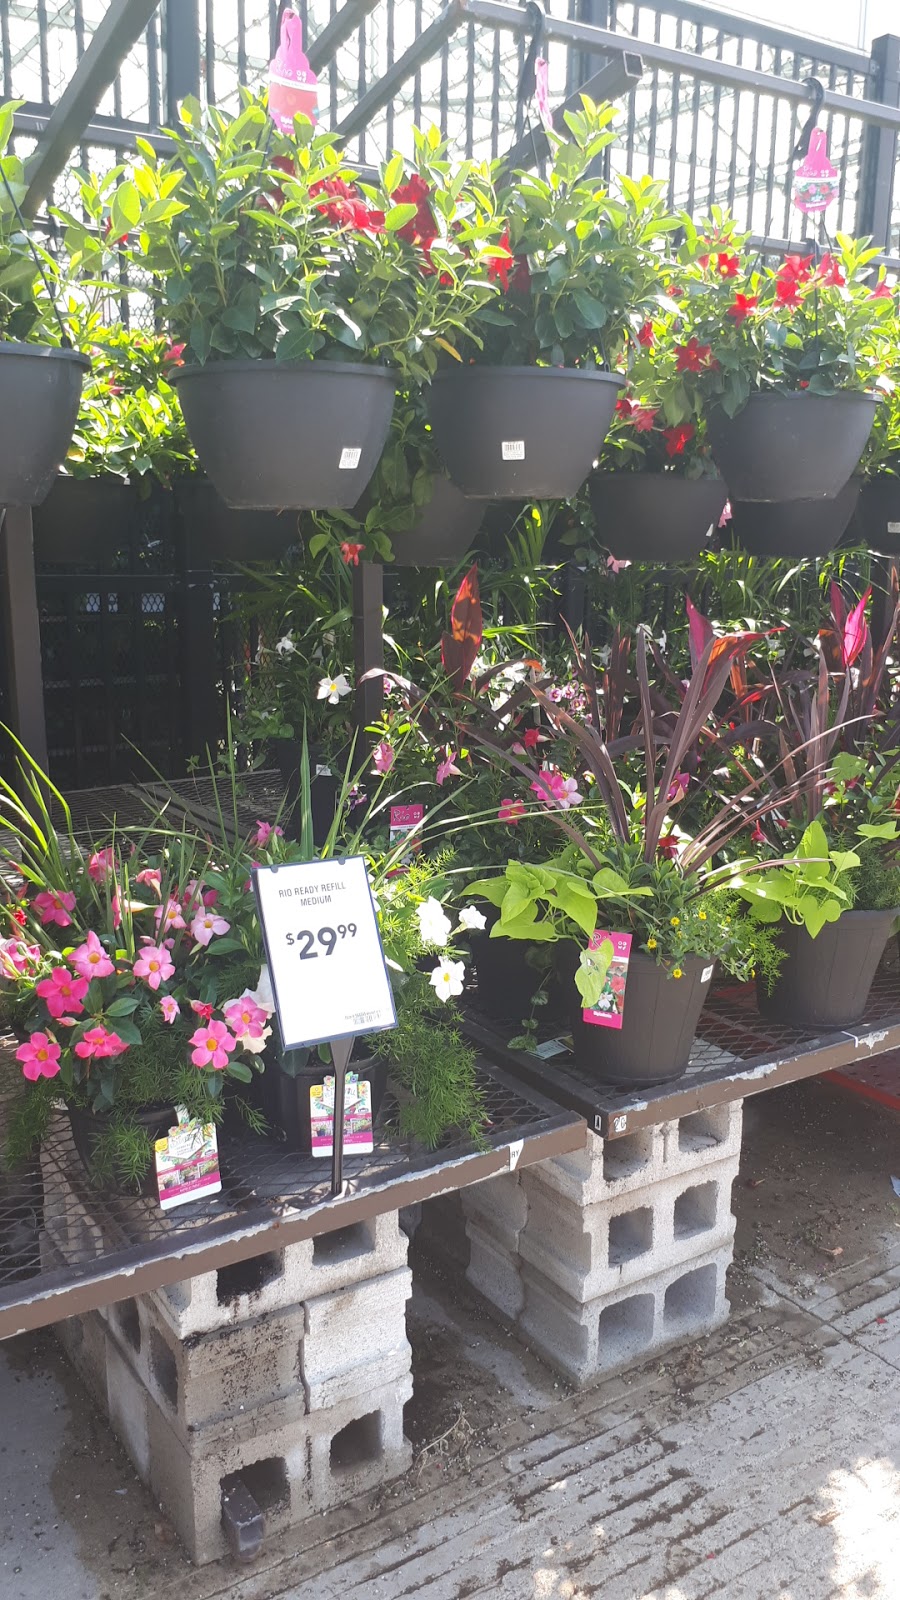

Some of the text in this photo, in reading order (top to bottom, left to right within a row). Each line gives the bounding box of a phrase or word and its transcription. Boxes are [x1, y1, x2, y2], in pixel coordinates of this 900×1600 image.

[278, 881, 346, 898] RIO READY REFILL
[300, 896, 332, 906] MEDIUM
